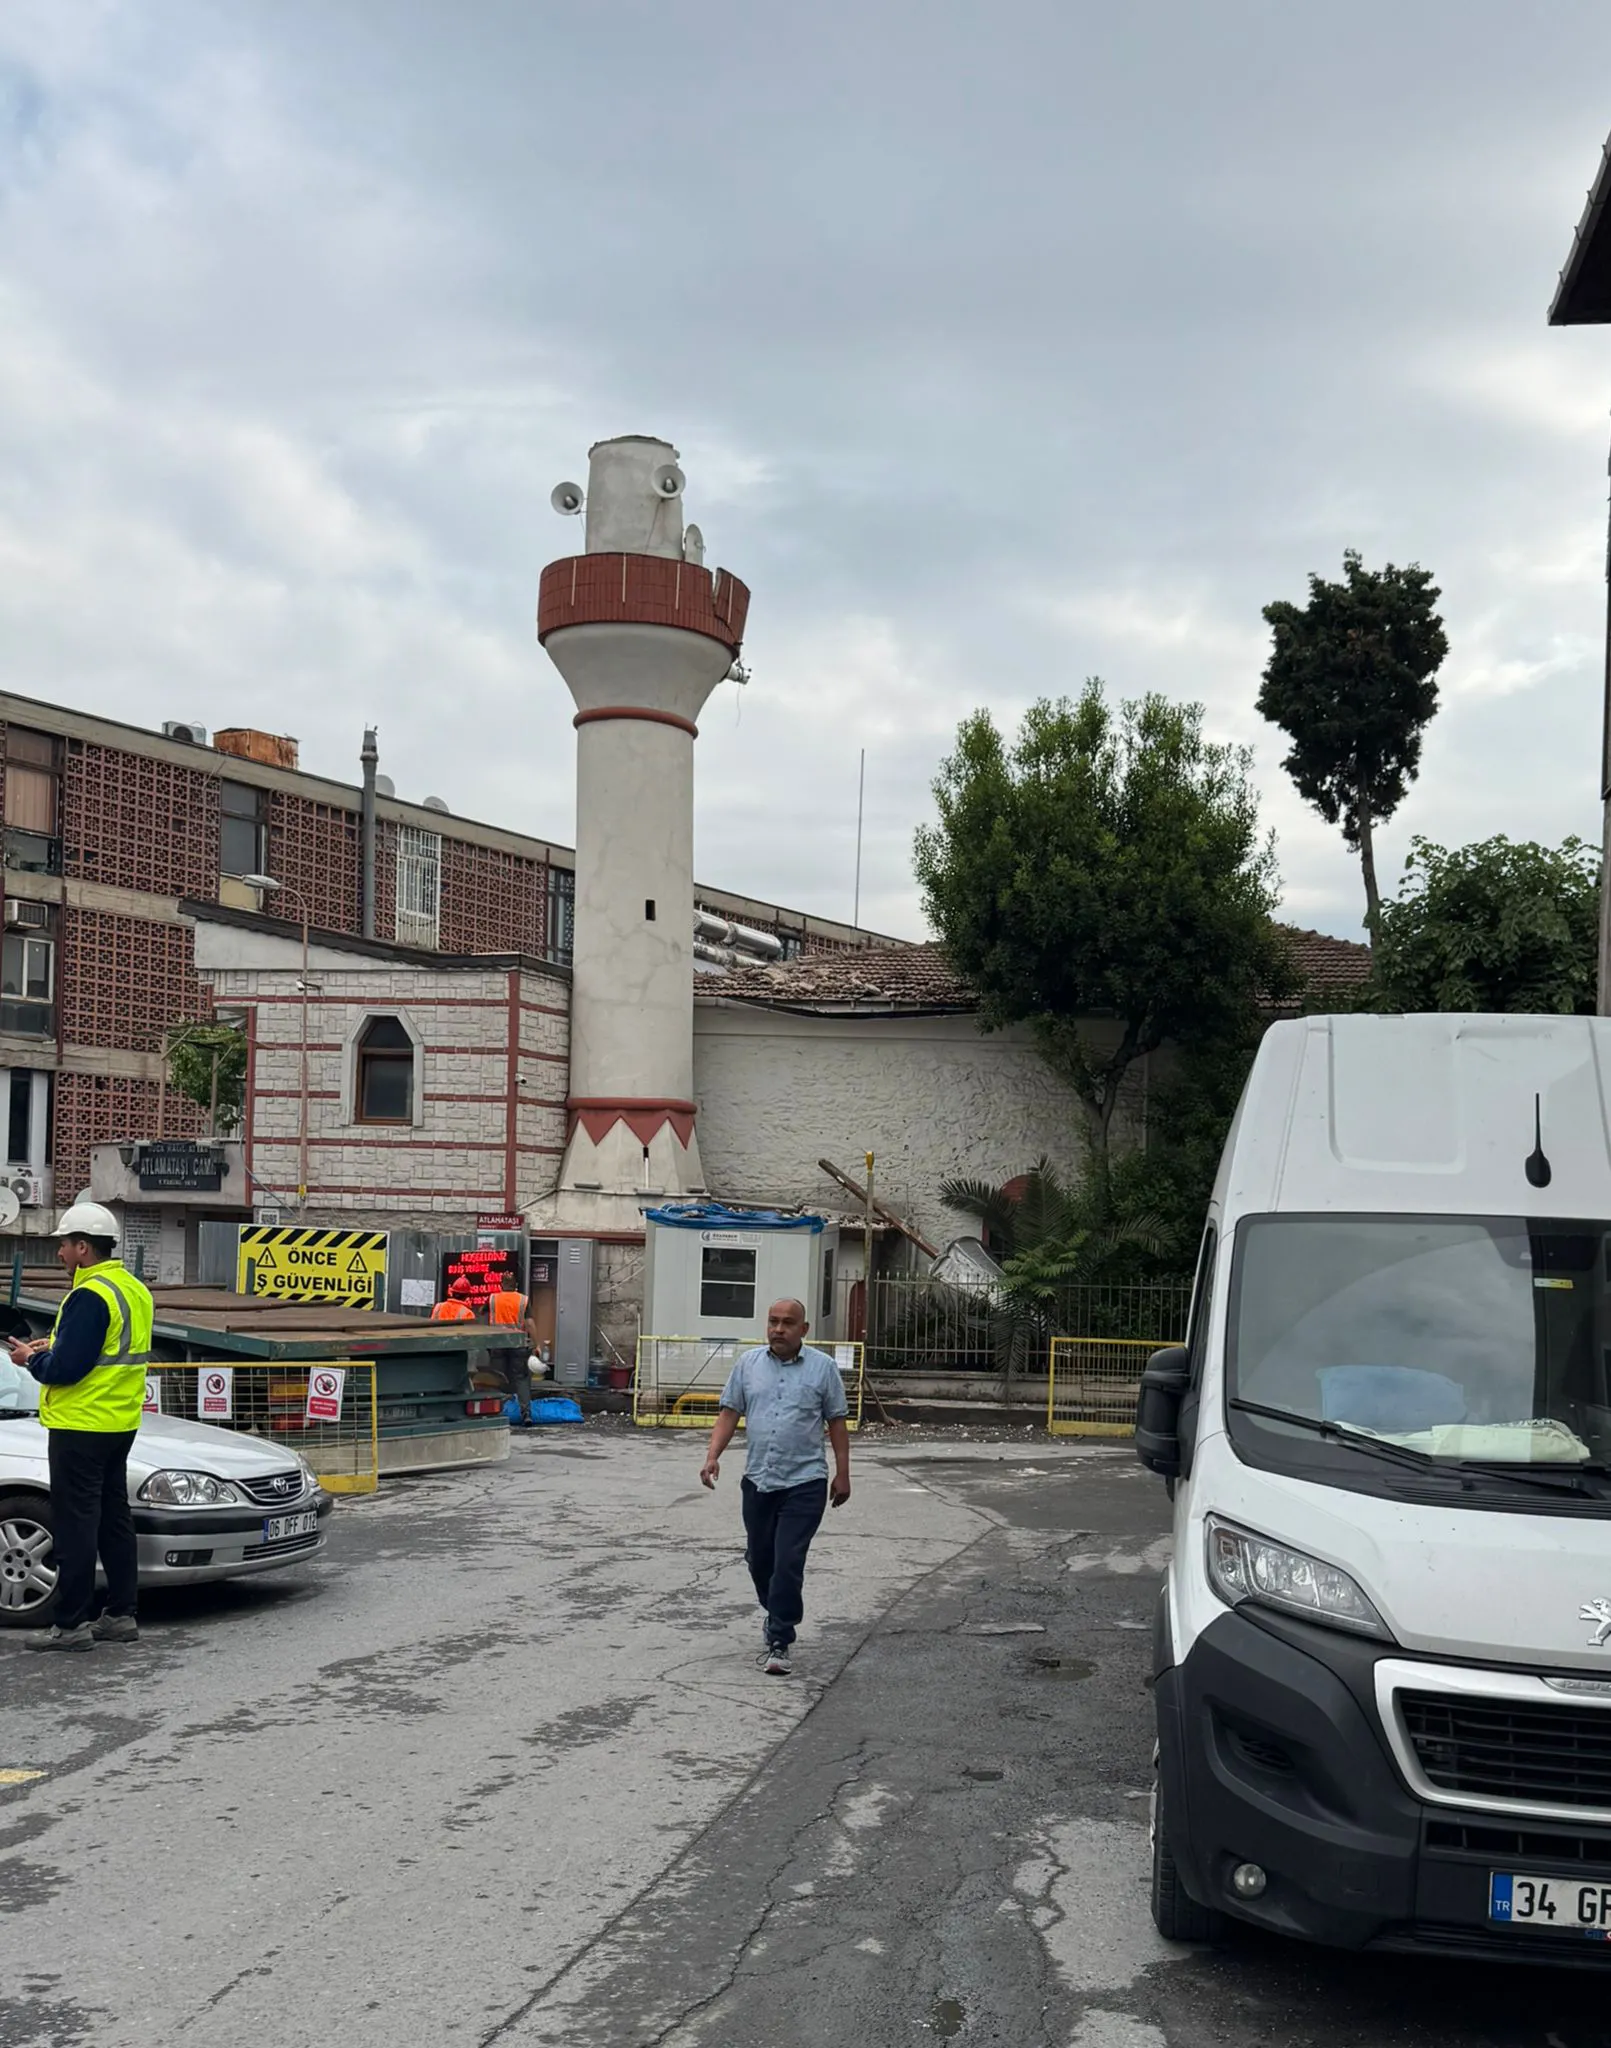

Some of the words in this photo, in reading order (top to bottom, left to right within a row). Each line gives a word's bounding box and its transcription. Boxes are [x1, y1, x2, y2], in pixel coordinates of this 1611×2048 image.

[140, 1157, 188, 1180] ATLAMATAŞI
[288, 1247, 337, 1266] ÖNCE
[273, 1272, 372, 1293] GÜVENLİĞİ
[269, 1519, 280, 1538] 06
[1495, 1900, 1511, 1912] TR
[1516, 1881, 1557, 1920] 34
